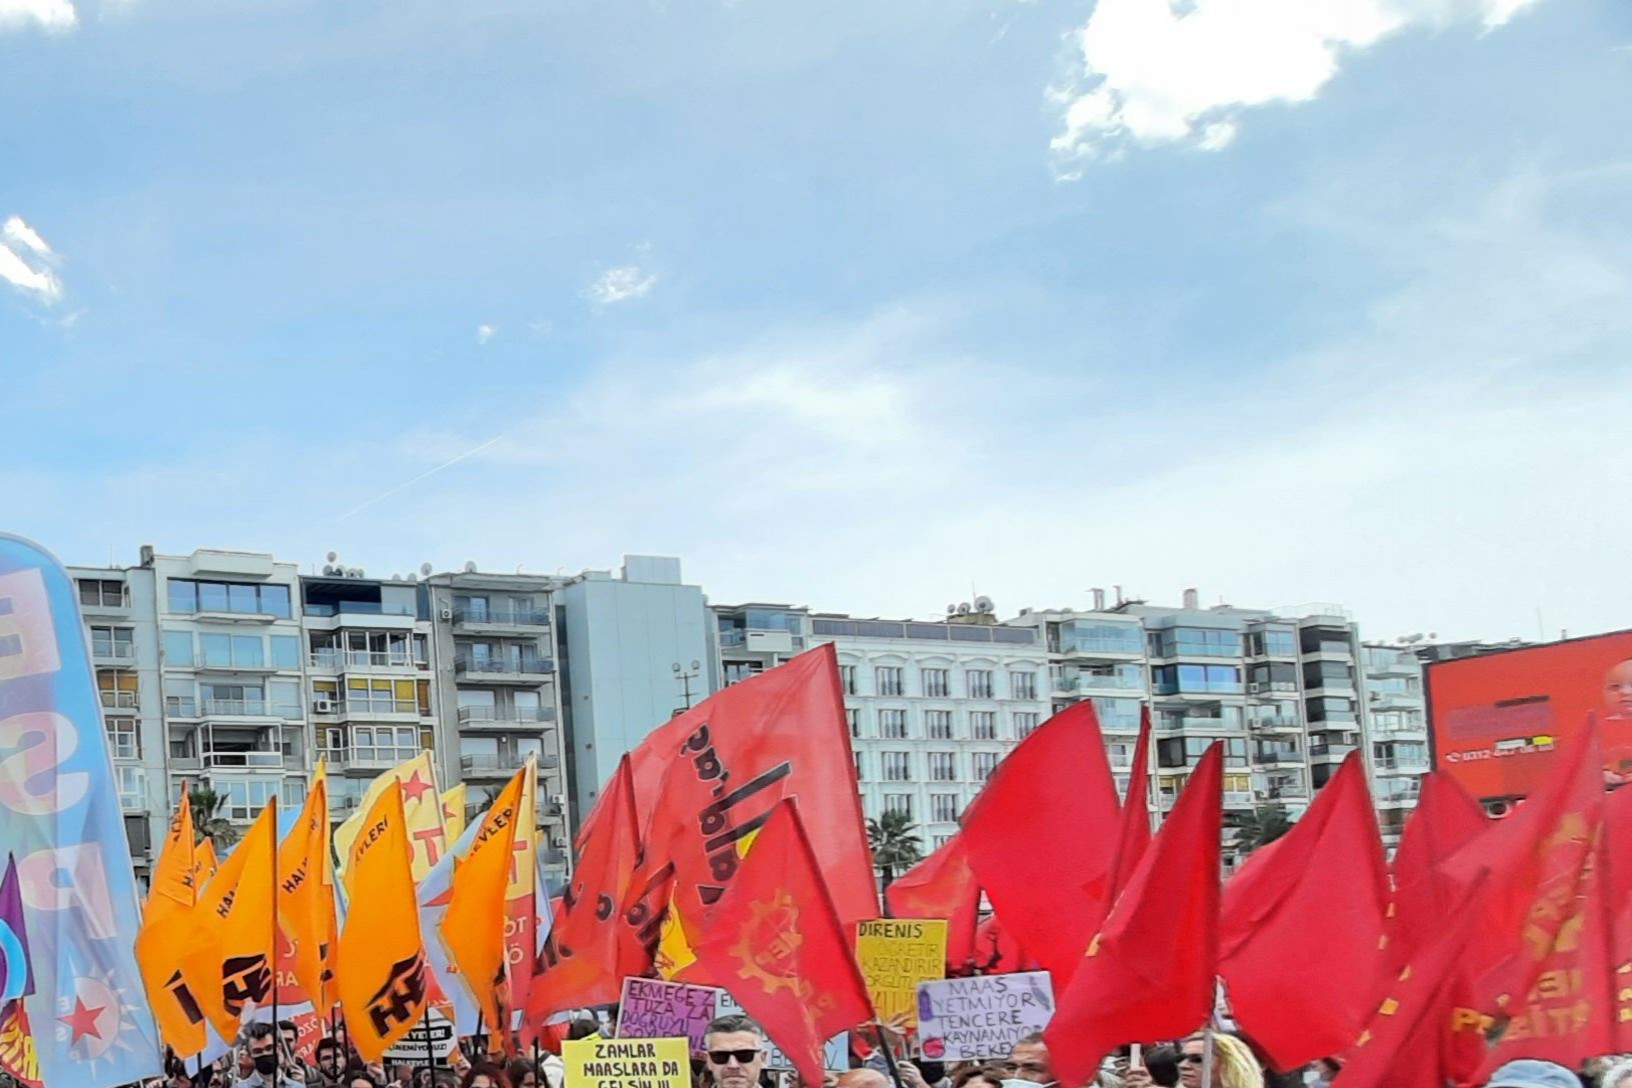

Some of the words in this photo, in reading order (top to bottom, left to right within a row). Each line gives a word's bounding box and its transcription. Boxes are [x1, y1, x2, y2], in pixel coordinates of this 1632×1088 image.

[935, 1009, 1023, 1030] TENCERE
[594, 1042, 656, 1059] ZAMLAR
[662, 1061, 679, 1076] DA
